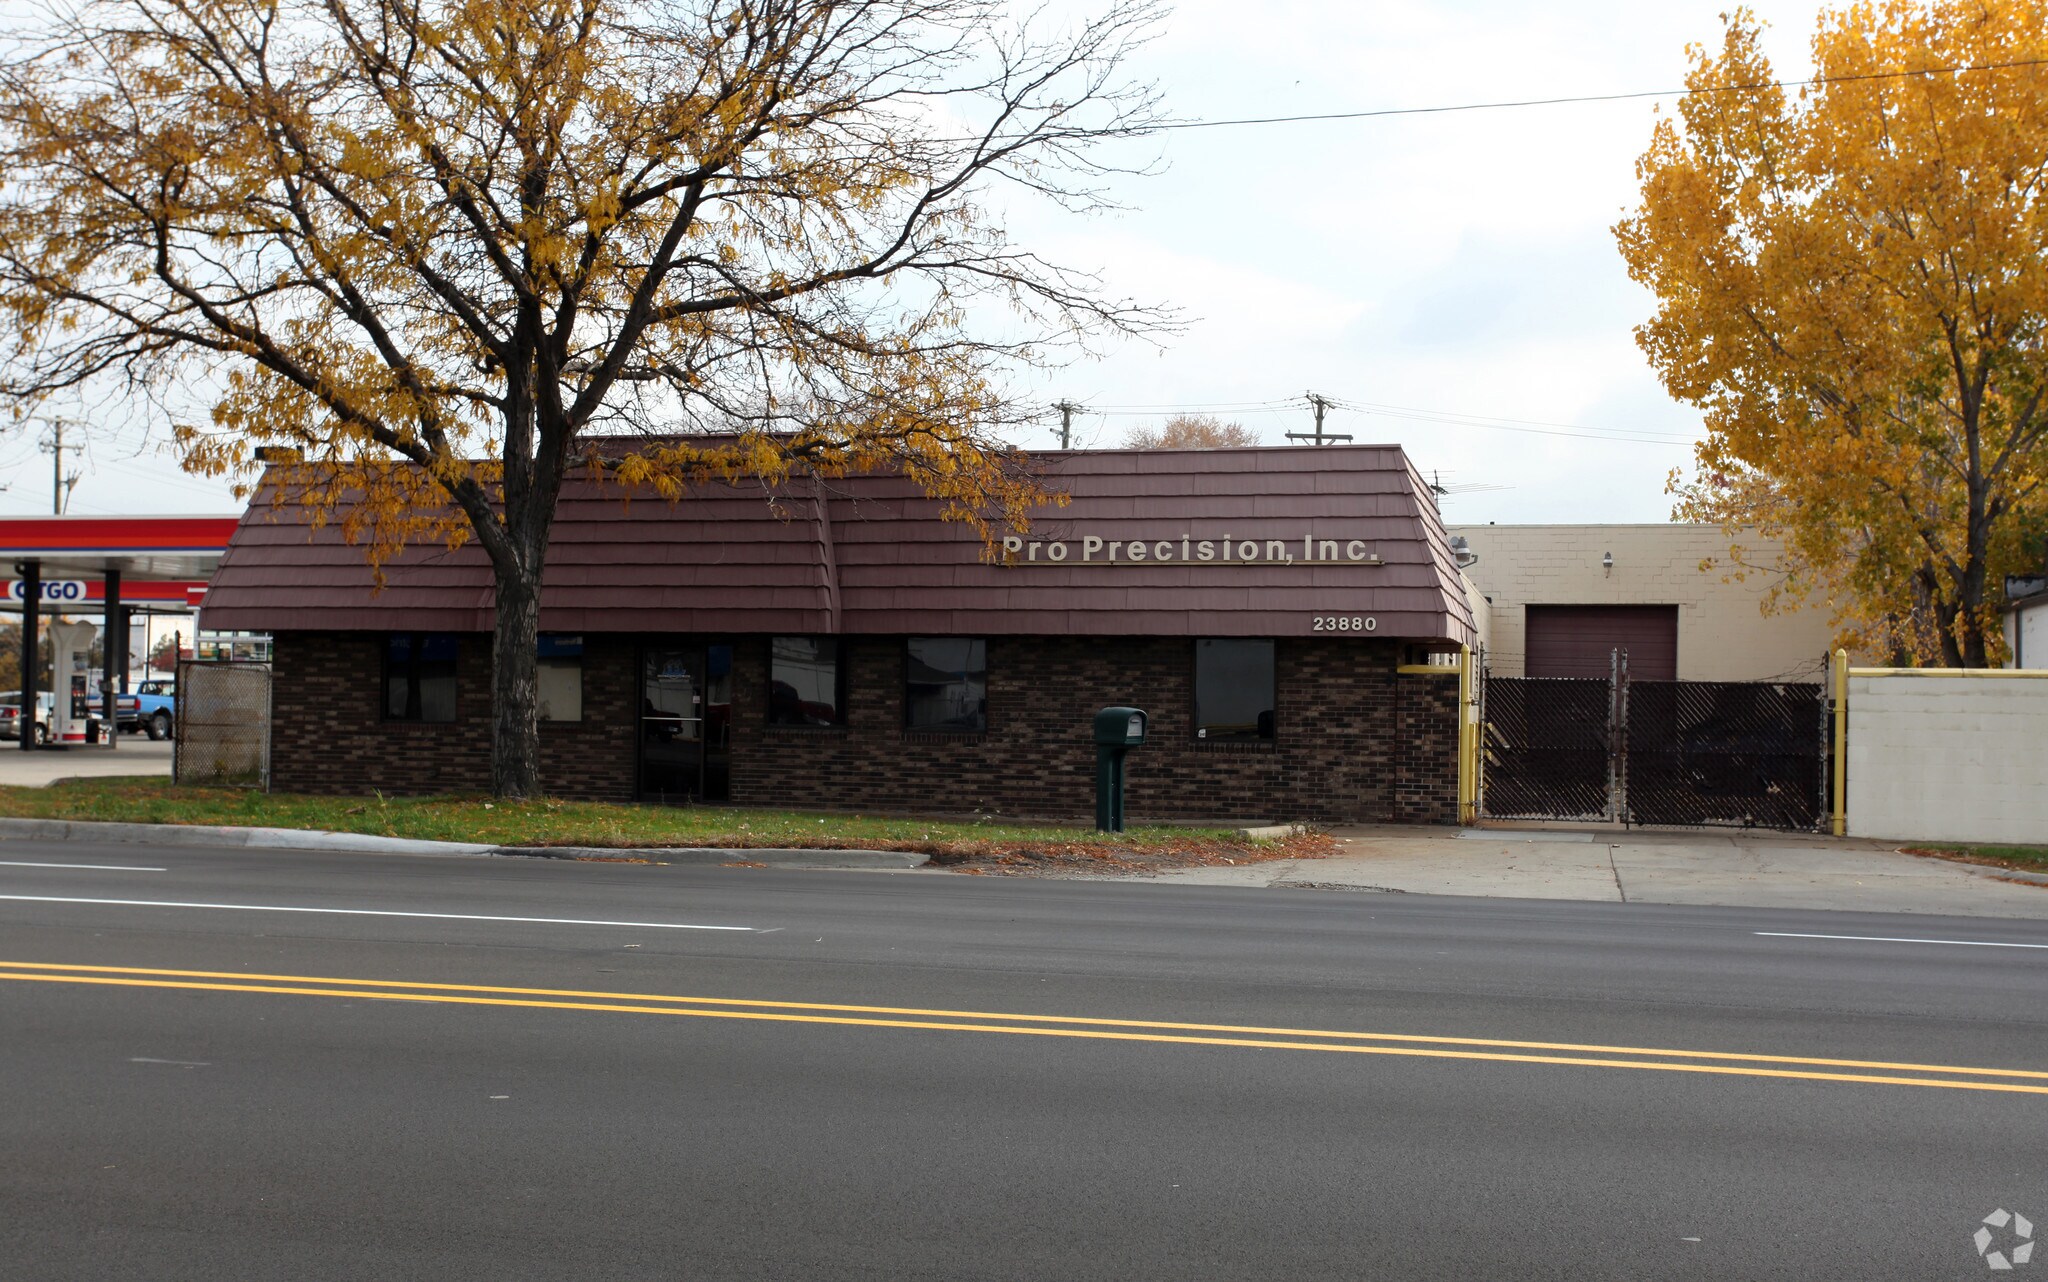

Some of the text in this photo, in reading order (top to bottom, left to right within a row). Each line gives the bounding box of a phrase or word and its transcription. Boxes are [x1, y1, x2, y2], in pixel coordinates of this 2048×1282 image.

[1002, 534, 1378, 566] Pro Precision, Inc.
[15, 582, 79, 600] CTGO
[1313, 616, 1378, 632] 23880
